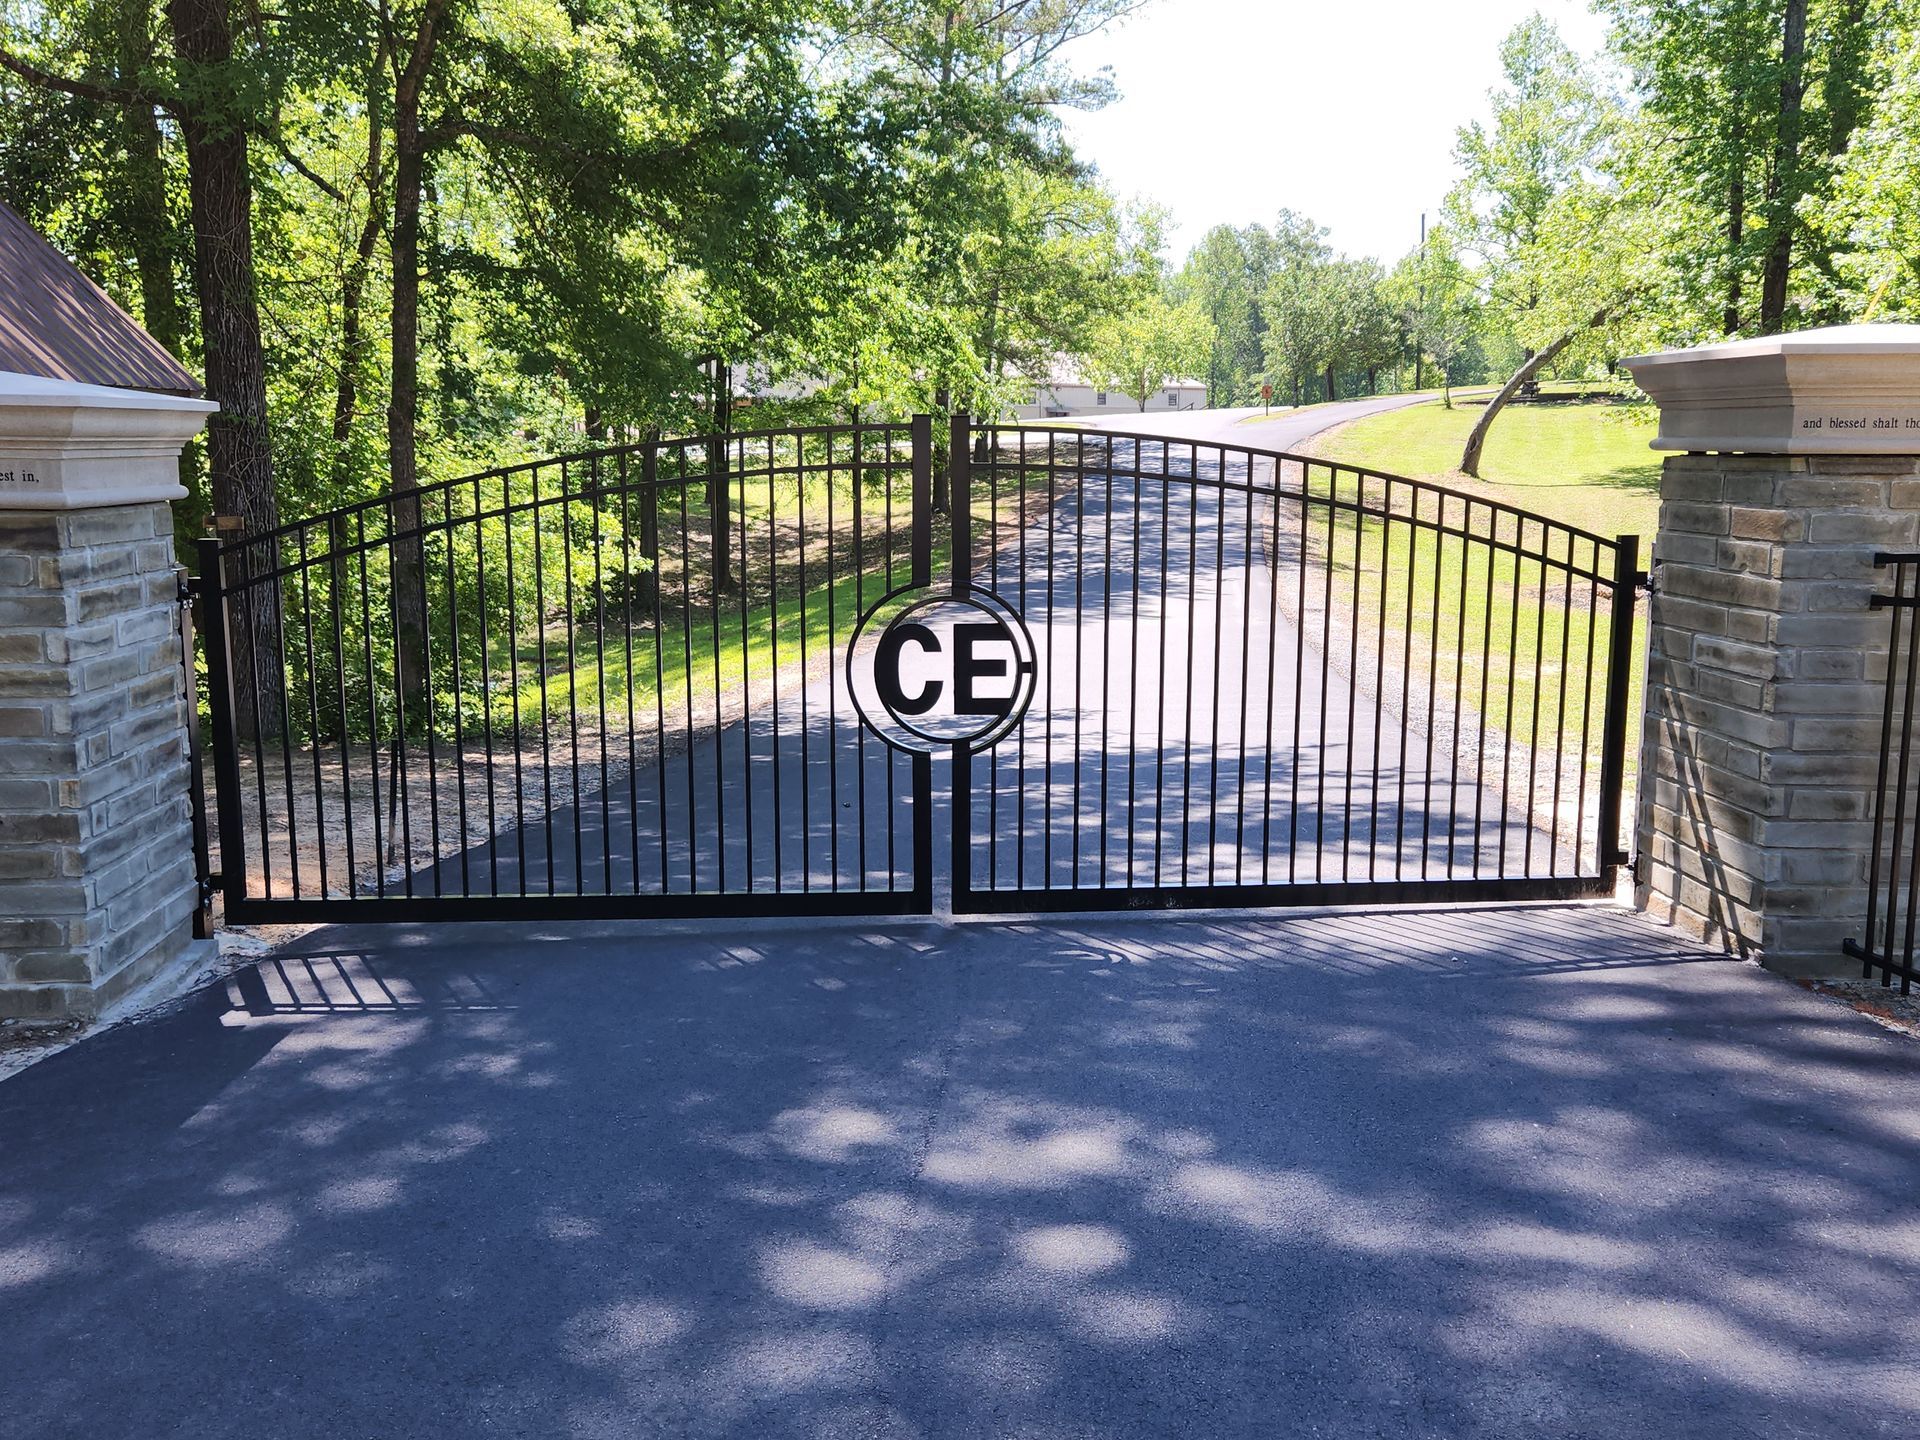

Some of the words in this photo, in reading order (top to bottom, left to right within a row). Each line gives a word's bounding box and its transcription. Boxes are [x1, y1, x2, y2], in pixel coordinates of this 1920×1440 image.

[1803, 417, 1822, 429] and
[1829, 417, 1866, 429] blessed
[1872, 417, 1898, 429] shalt
[874, 623, 1018, 715] CE
